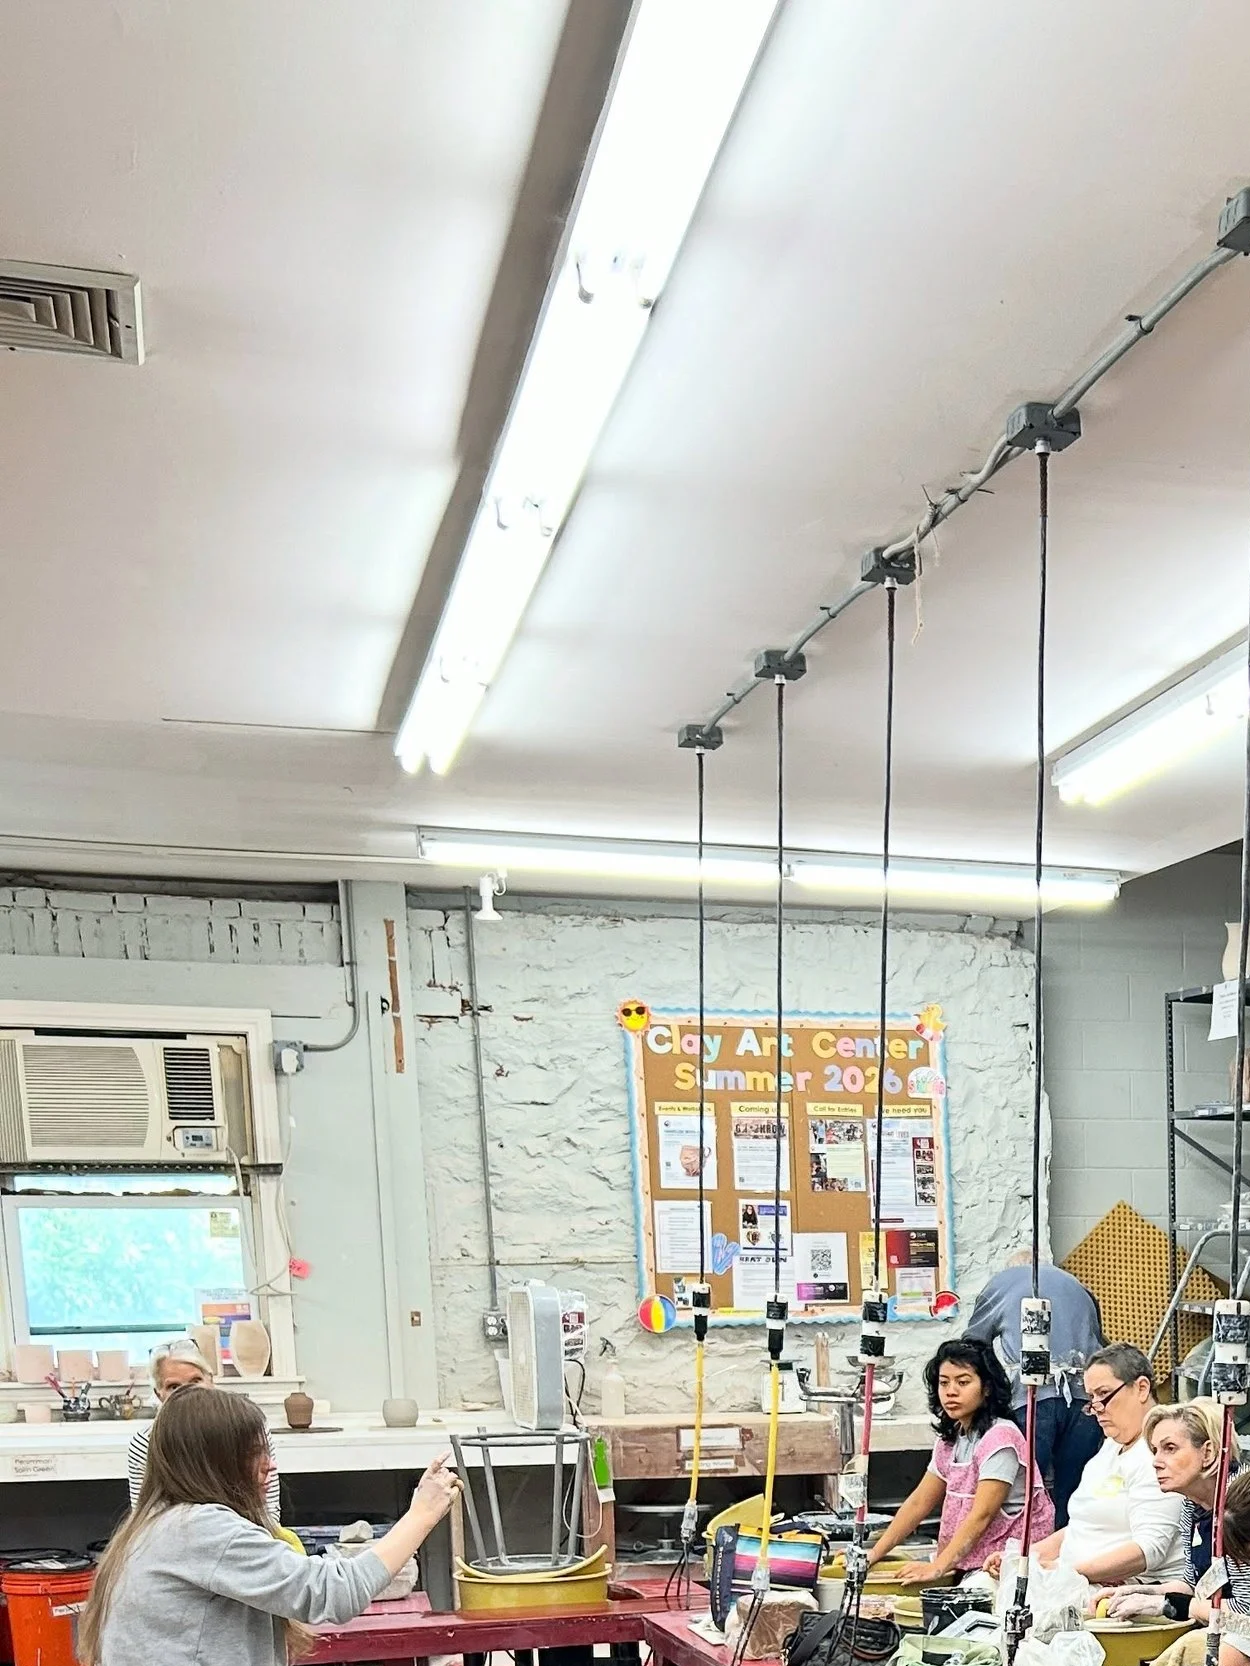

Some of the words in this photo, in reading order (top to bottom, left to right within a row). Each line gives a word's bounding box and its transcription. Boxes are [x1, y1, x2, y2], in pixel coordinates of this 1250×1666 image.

[646, 1025, 722, 1063] Clay
[735, 1028, 794, 1057] Art
[811, 1031, 925, 1059] Center
[674, 1062, 813, 1092] Summer
[823, 1064, 903, 1094] 2026
[738, 1105, 770, 1114] Coming
